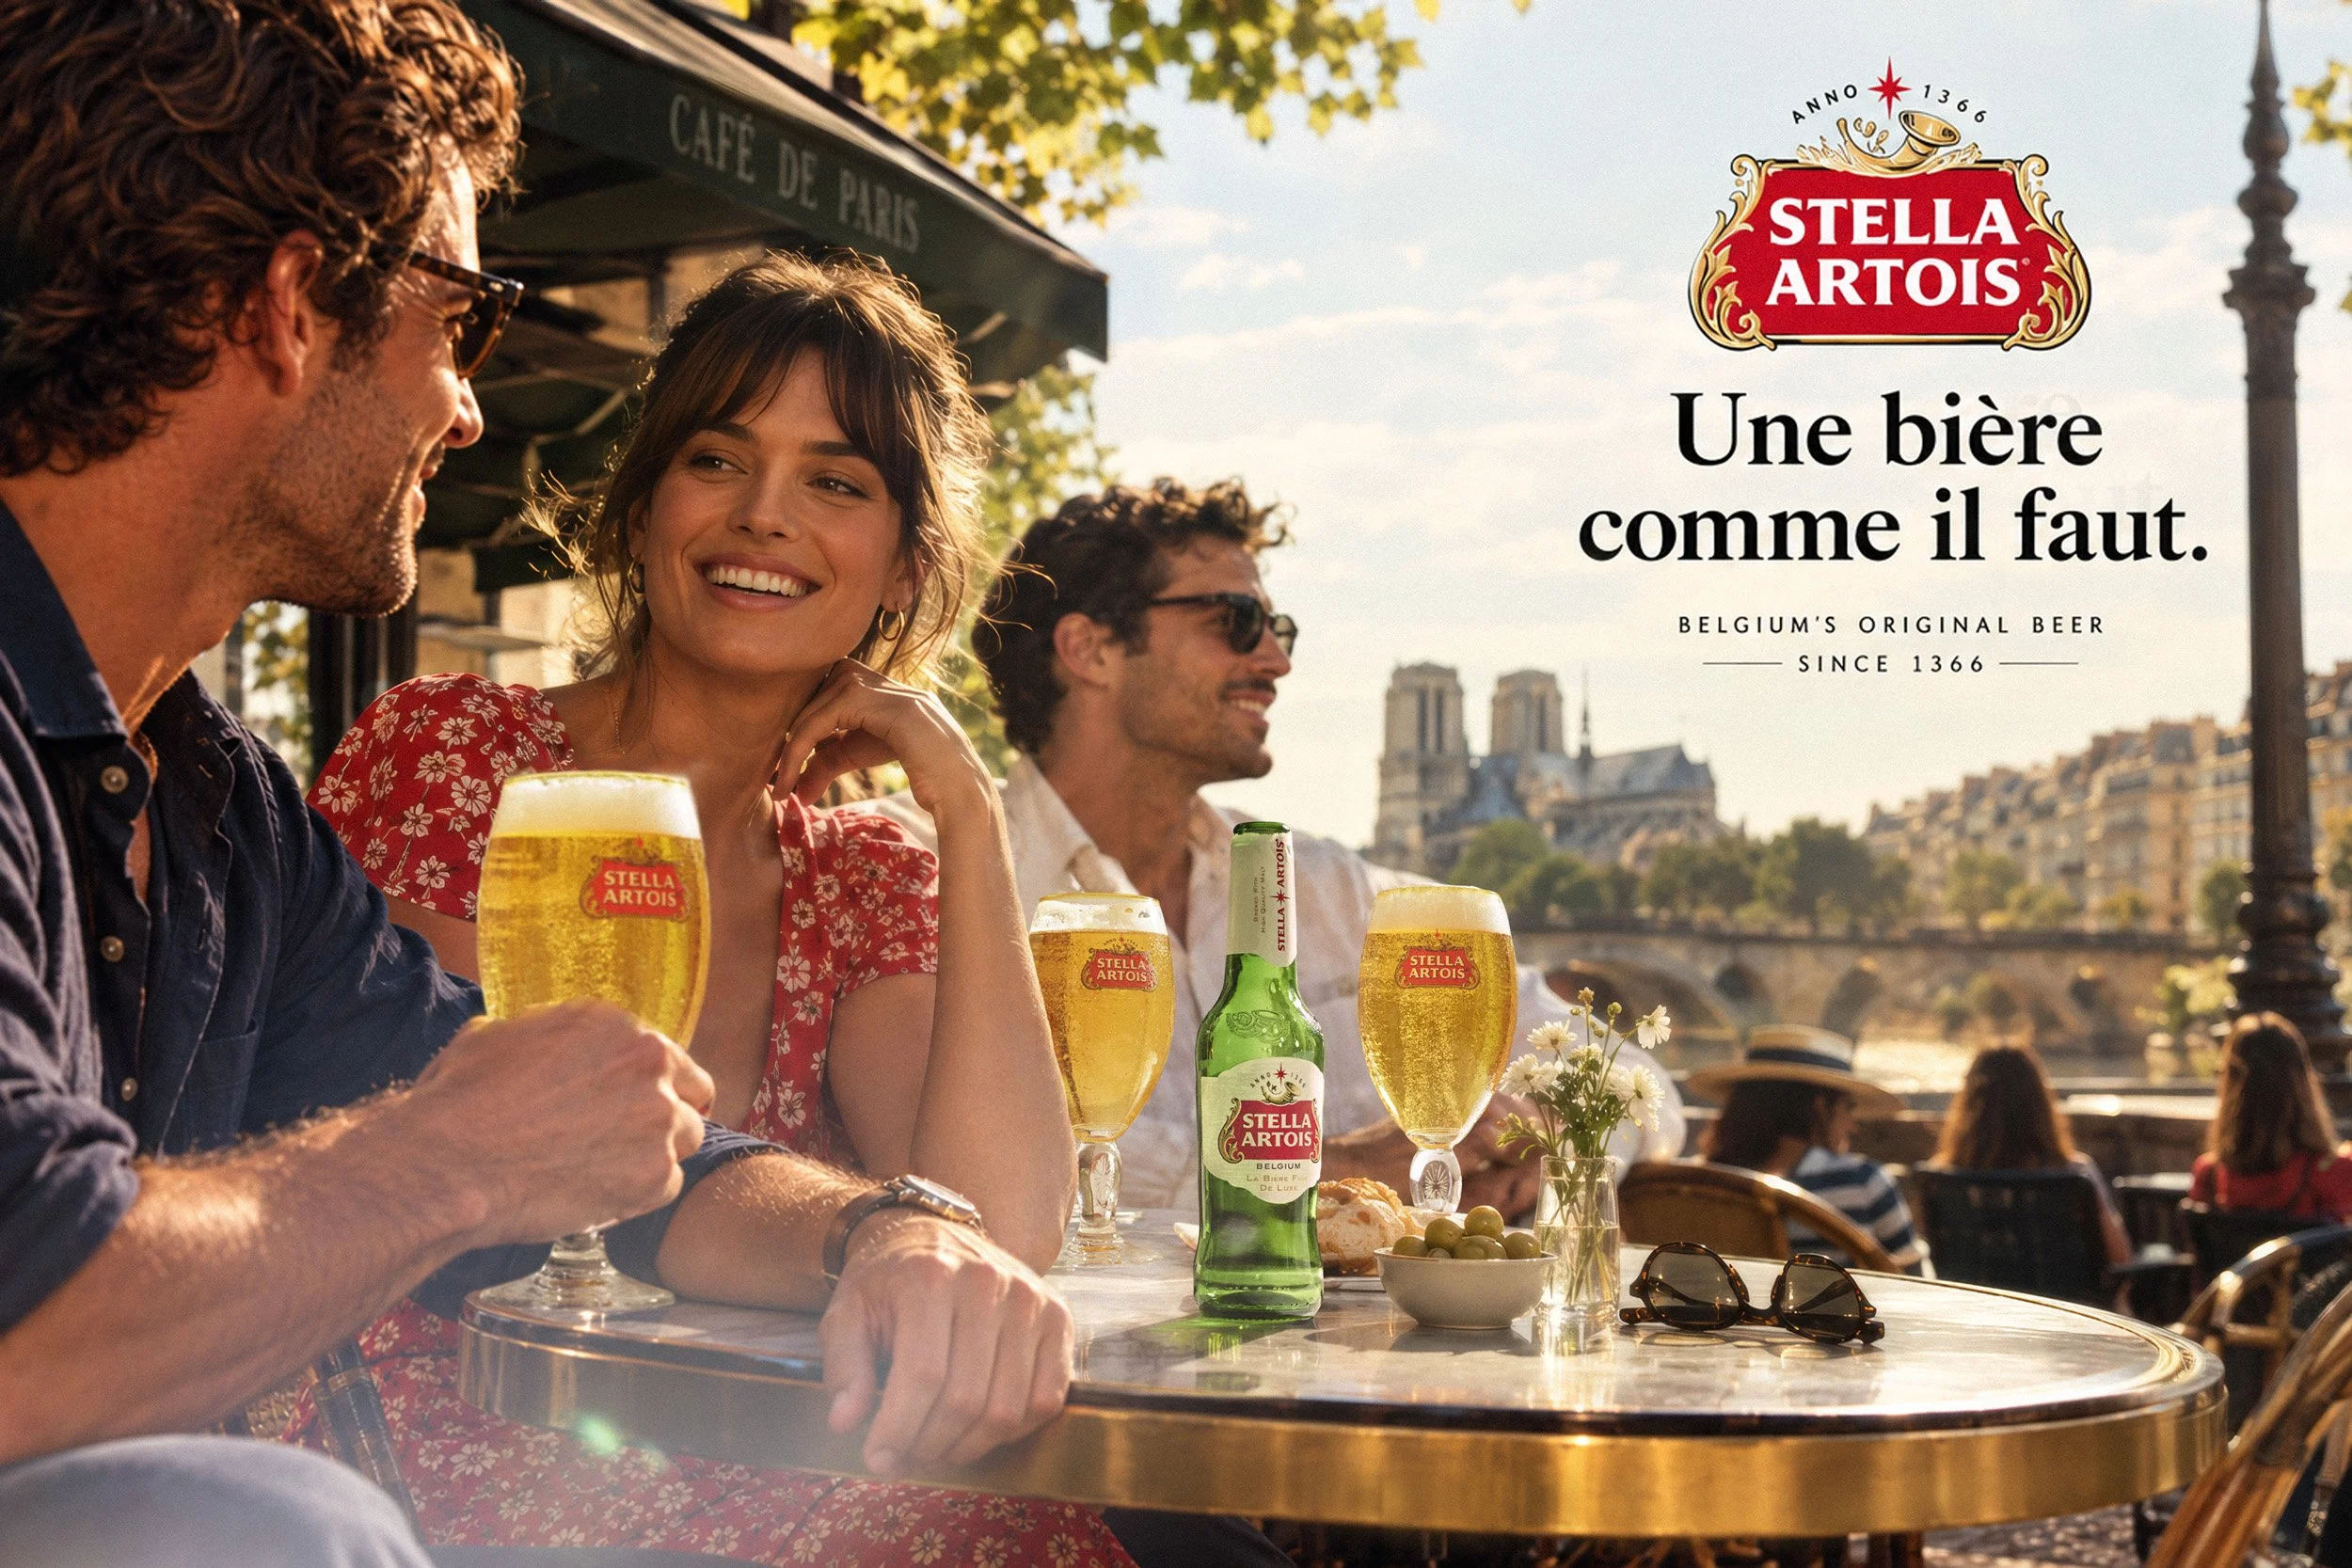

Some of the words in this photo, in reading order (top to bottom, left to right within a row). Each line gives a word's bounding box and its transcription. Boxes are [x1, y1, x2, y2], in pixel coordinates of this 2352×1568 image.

[669, 94, 755, 184] CAFÉ
[777, 140, 818, 212] DE
[837, 166, 921, 255] PARIS
[1276, 841, 1285, 888] ARTOIS
[603, 870, 675, 889] STELLA
[602, 888, 676, 908] ARTOIS
[1277, 908, 1285, 952] STELLA
[1097, 958, 1147, 971] STELLA
[1410, 955, 1465, 966] STELLA
[1096, 970, 1147, 982] ARTOIS
[1409, 968, 1466, 979] ARTOIS
[1249, 1072, 1271, 1088] ANNO
[1242, 1113, 1311, 1129] STELLA
[1241, 1131, 1312, 1148] ARTOIS
